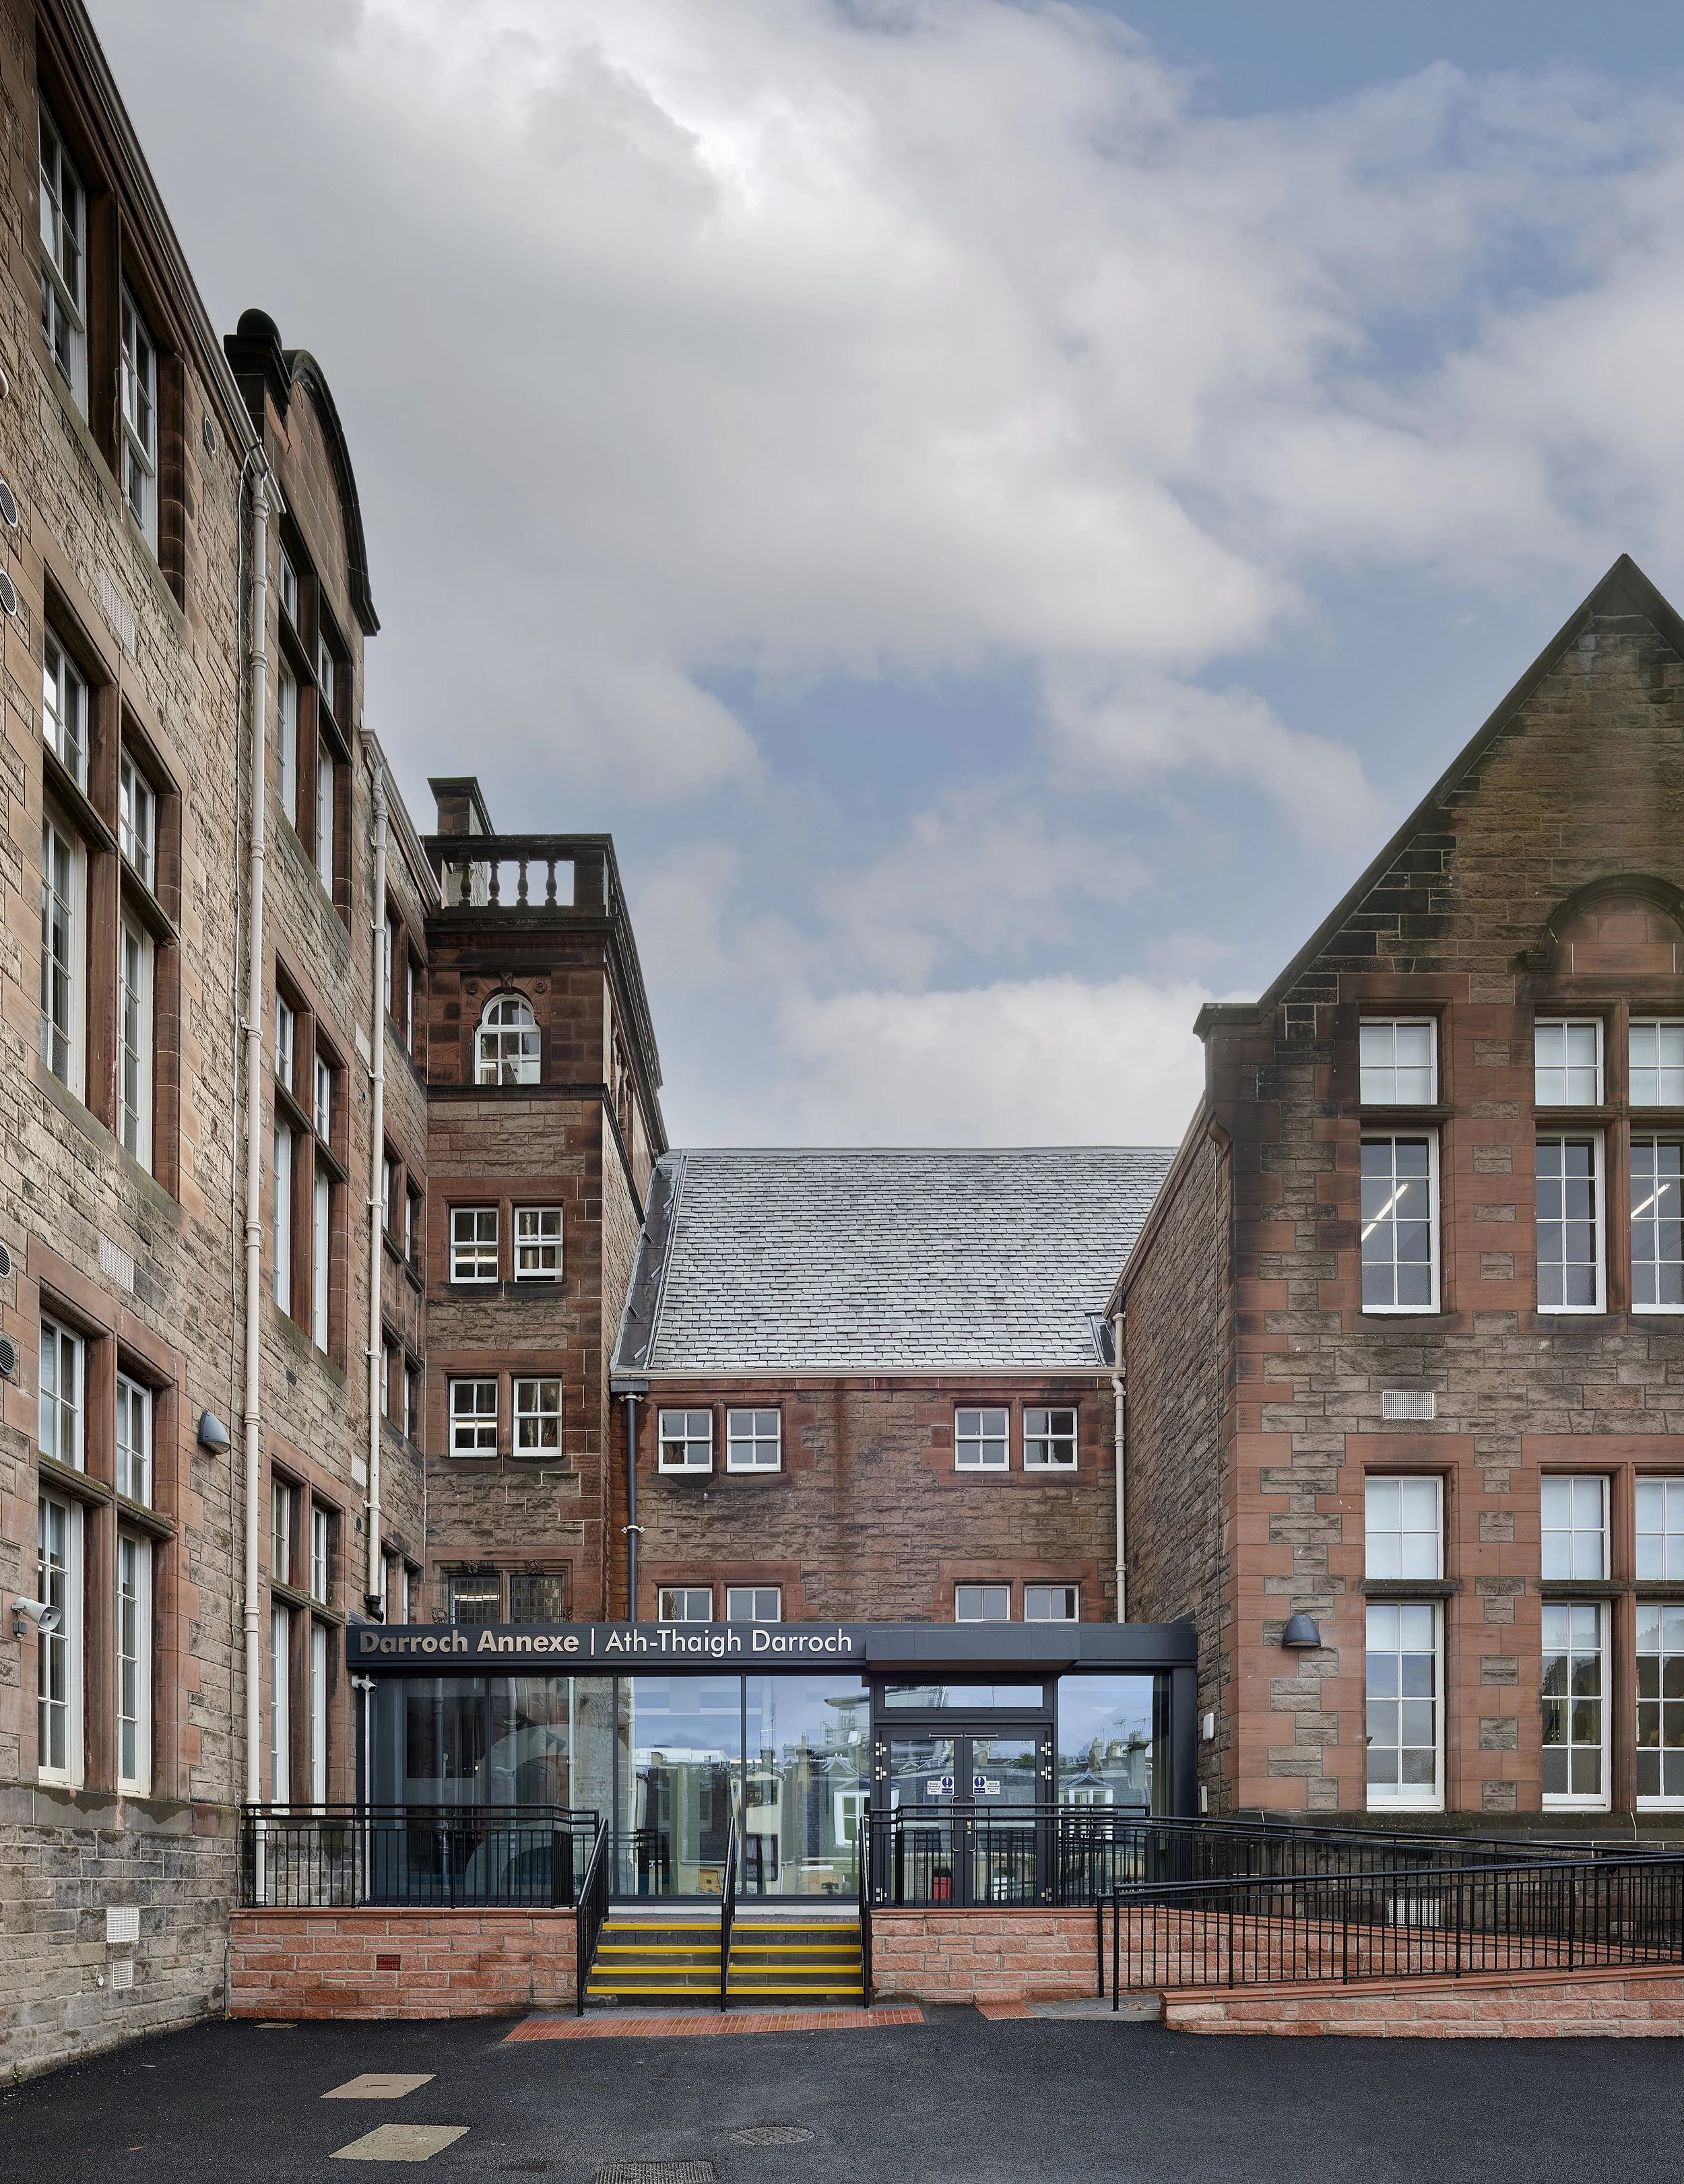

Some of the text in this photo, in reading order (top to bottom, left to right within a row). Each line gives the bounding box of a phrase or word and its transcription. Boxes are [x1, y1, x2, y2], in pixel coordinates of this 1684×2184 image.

[360, 1628, 852, 1657] Darroch Annexe Ath-Thaigh Darroch
